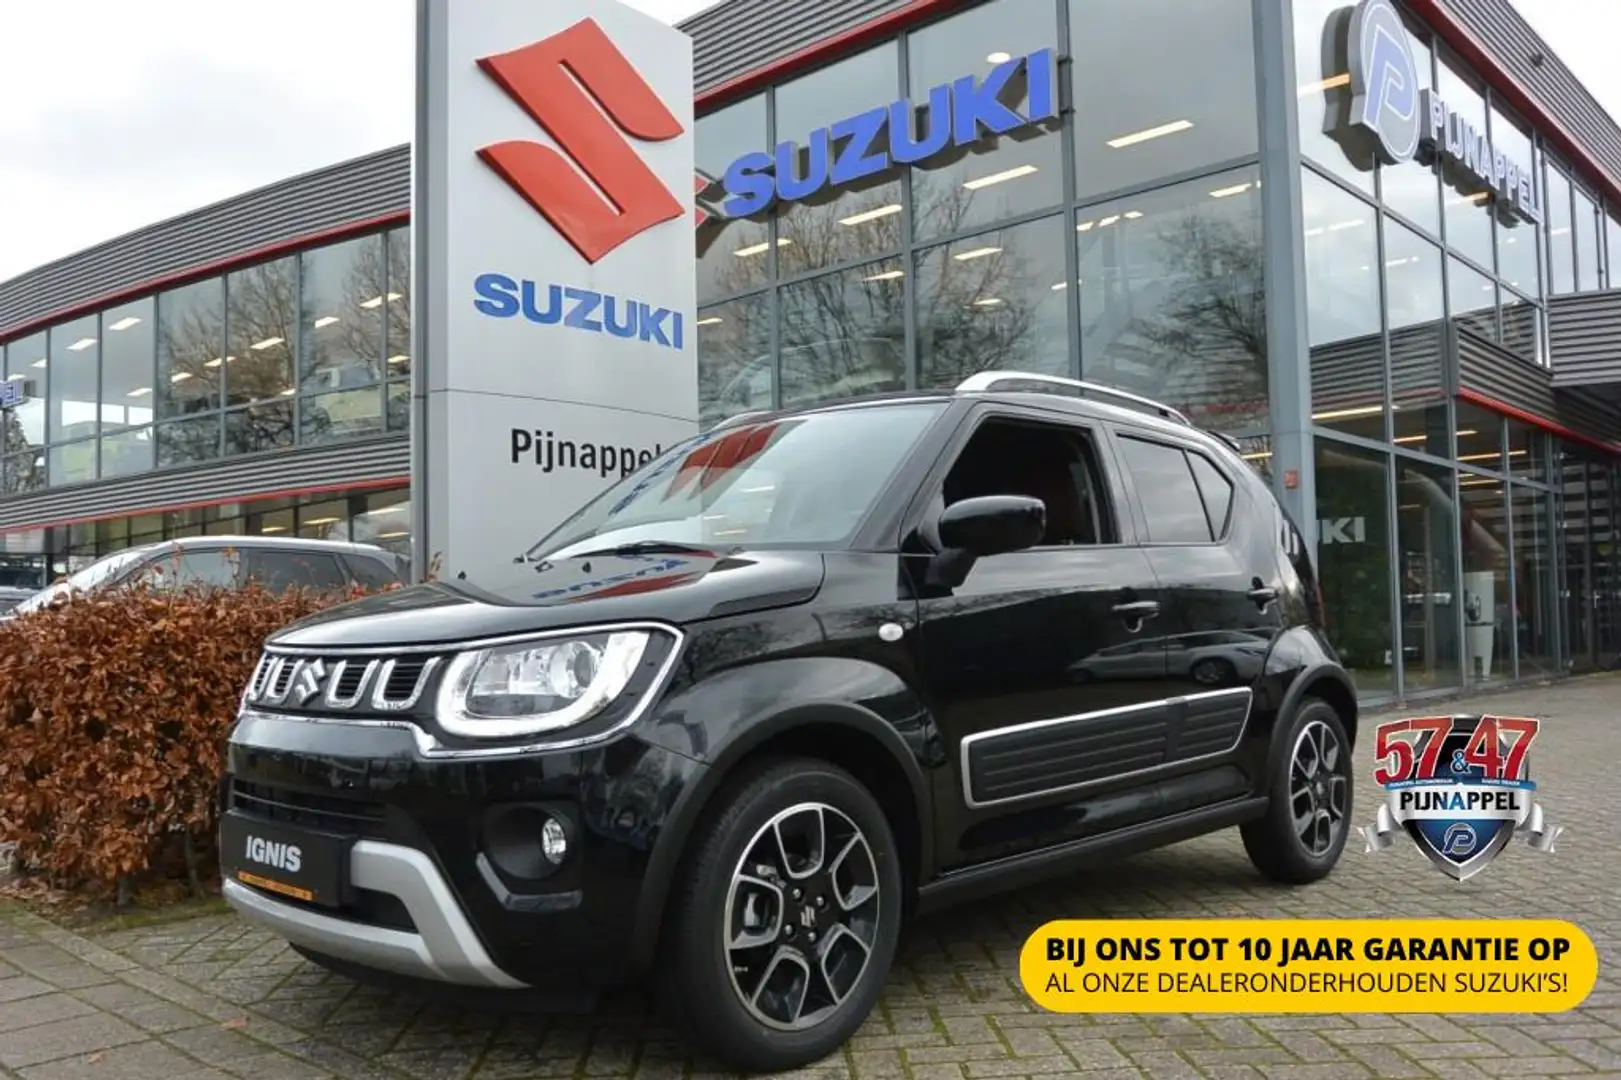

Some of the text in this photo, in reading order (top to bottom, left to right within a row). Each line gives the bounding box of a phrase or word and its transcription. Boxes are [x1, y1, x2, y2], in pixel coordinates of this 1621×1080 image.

[722, 48, 1059, 219] SUZUKI
[1428, 88, 1543, 225] PIJNAPPEL
[473, 273, 684, 350] SUZUKI
[245, 835, 301, 872] IGNIS
